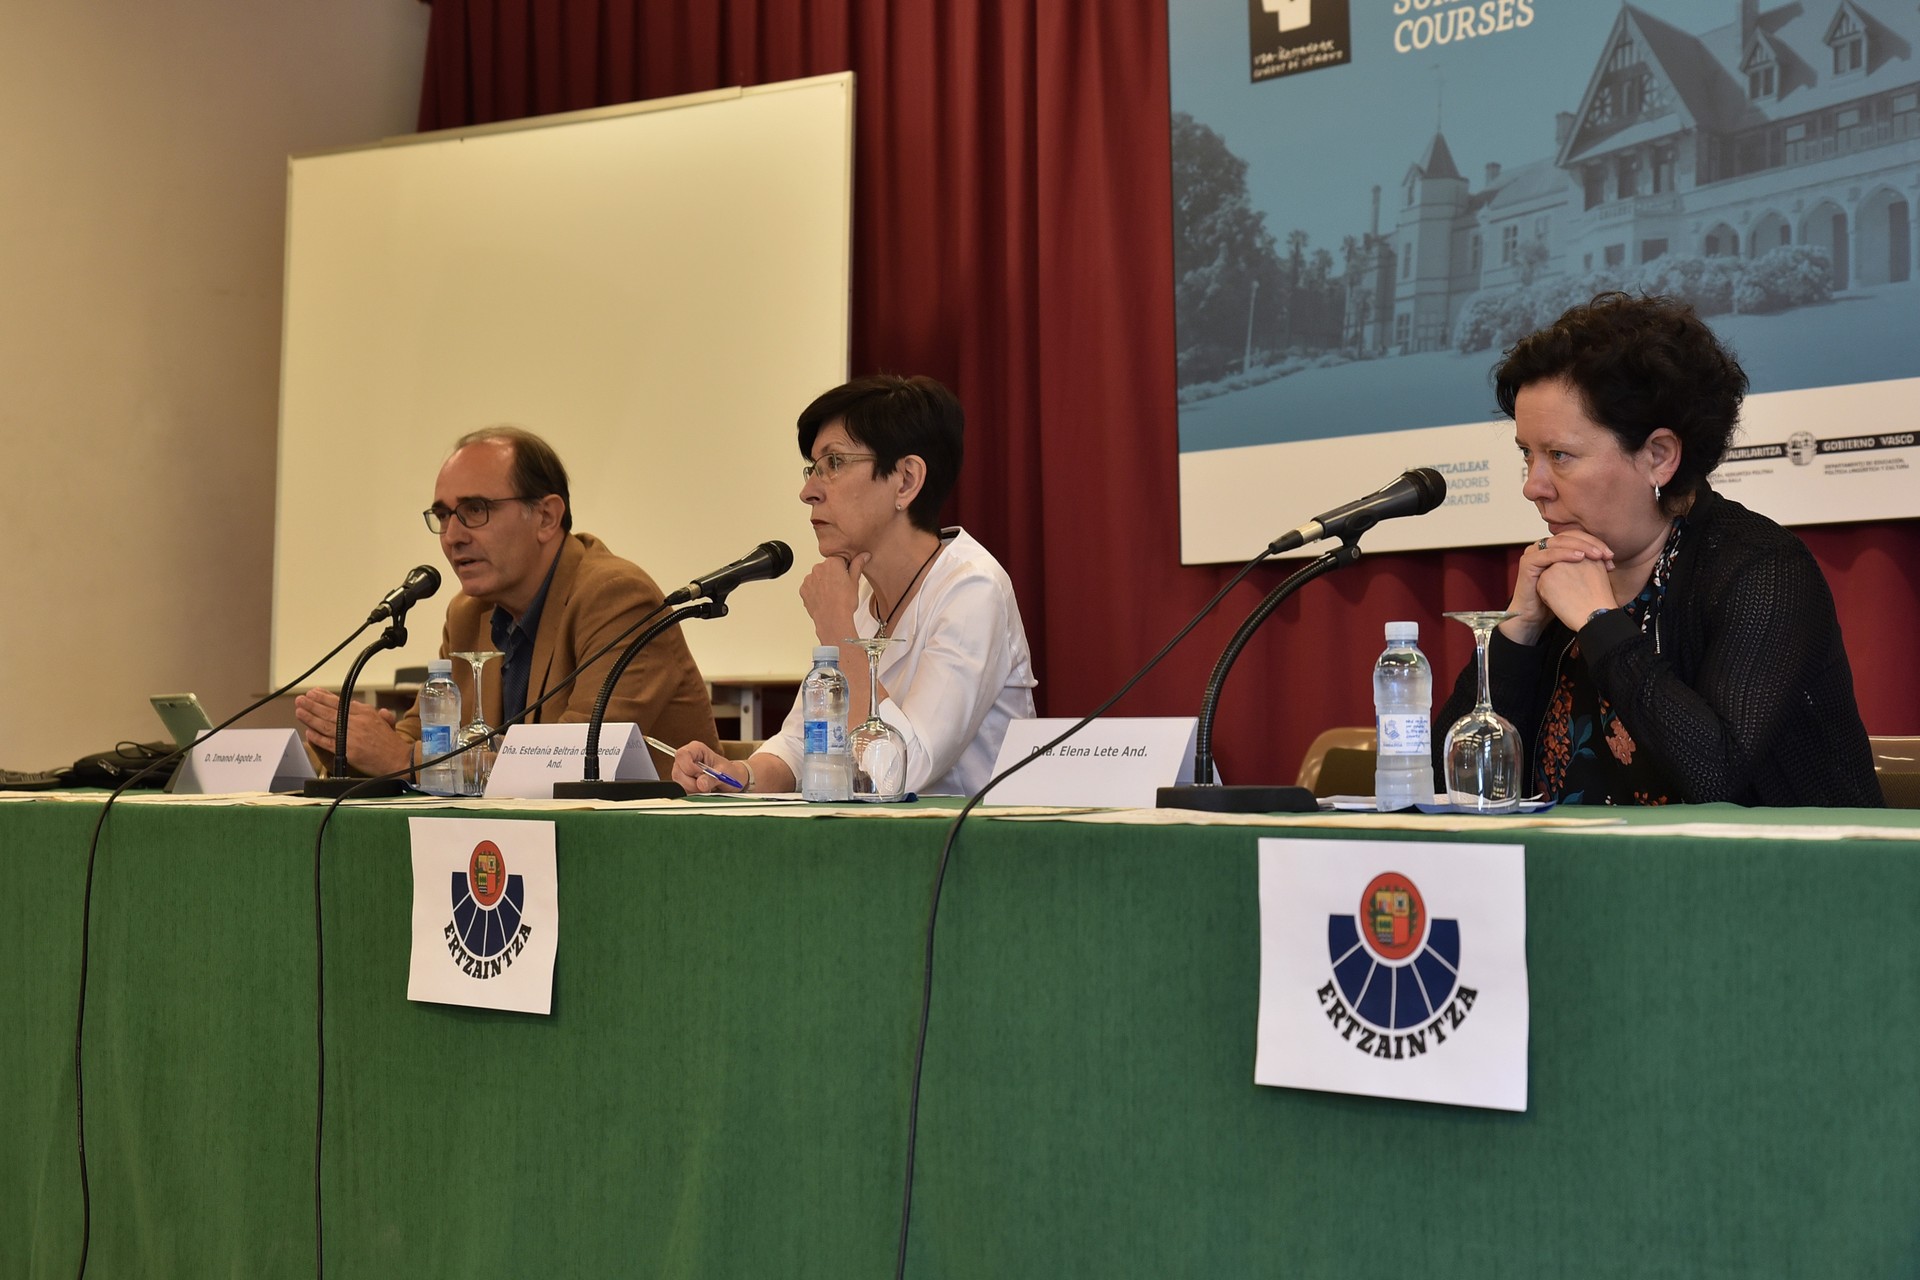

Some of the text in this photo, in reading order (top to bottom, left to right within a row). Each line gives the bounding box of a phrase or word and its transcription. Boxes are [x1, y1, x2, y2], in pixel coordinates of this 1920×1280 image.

[1394, 0, 1535, 53] COURSES
[1822, 434, 1915, 451] GOBIERNO VASCO
[502, 746, 518, 756] Dña.
[519, 745, 551, 756] Estefanía
[552, 745, 579, 756] Beltrán
[597, 746, 621, 756] eredia
[1031, 745, 1148, 757] Da. Elena Lete And.
[212, 753, 235, 762] Imanol
[235, 753, 252, 764] Agote
[546, 759, 562, 769] And.
[444, 920, 532, 979] ERTZAINTZA
[1316, 979, 1479, 1060] ERTZAINTZA
